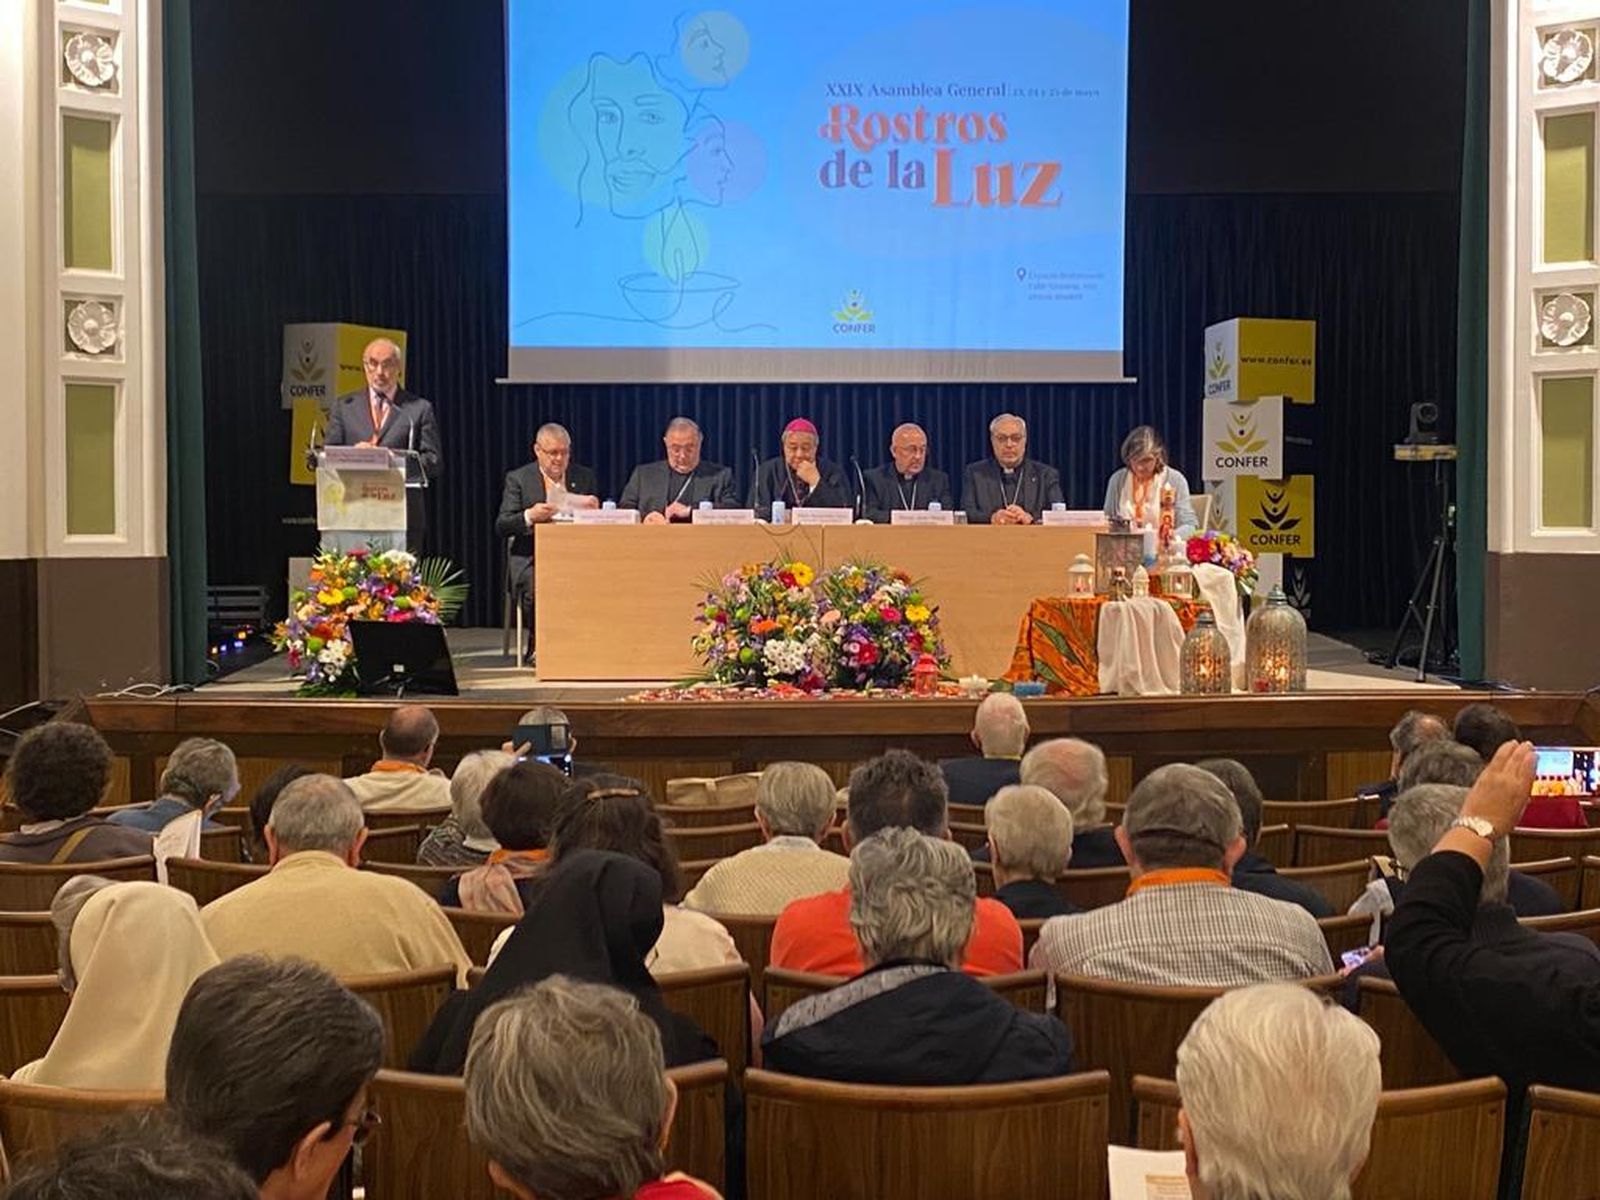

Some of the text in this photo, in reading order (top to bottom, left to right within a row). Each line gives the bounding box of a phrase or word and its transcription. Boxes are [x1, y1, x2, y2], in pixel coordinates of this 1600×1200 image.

[825, 82, 863, 97] XXIX
[868, 82, 943, 97] Asamblea
[947, 82, 1006, 97] General
[818, 103, 1008, 152] Rostros
[819, 148, 1064, 208] de la Luz
[832, 323, 876, 334] CONFER
[1240, 355, 1312, 366] www.confer.es
[289, 384, 326, 397] CONFER
[1215, 456, 1269, 468] CONFER
[1249, 533, 1301, 546] CONFER
